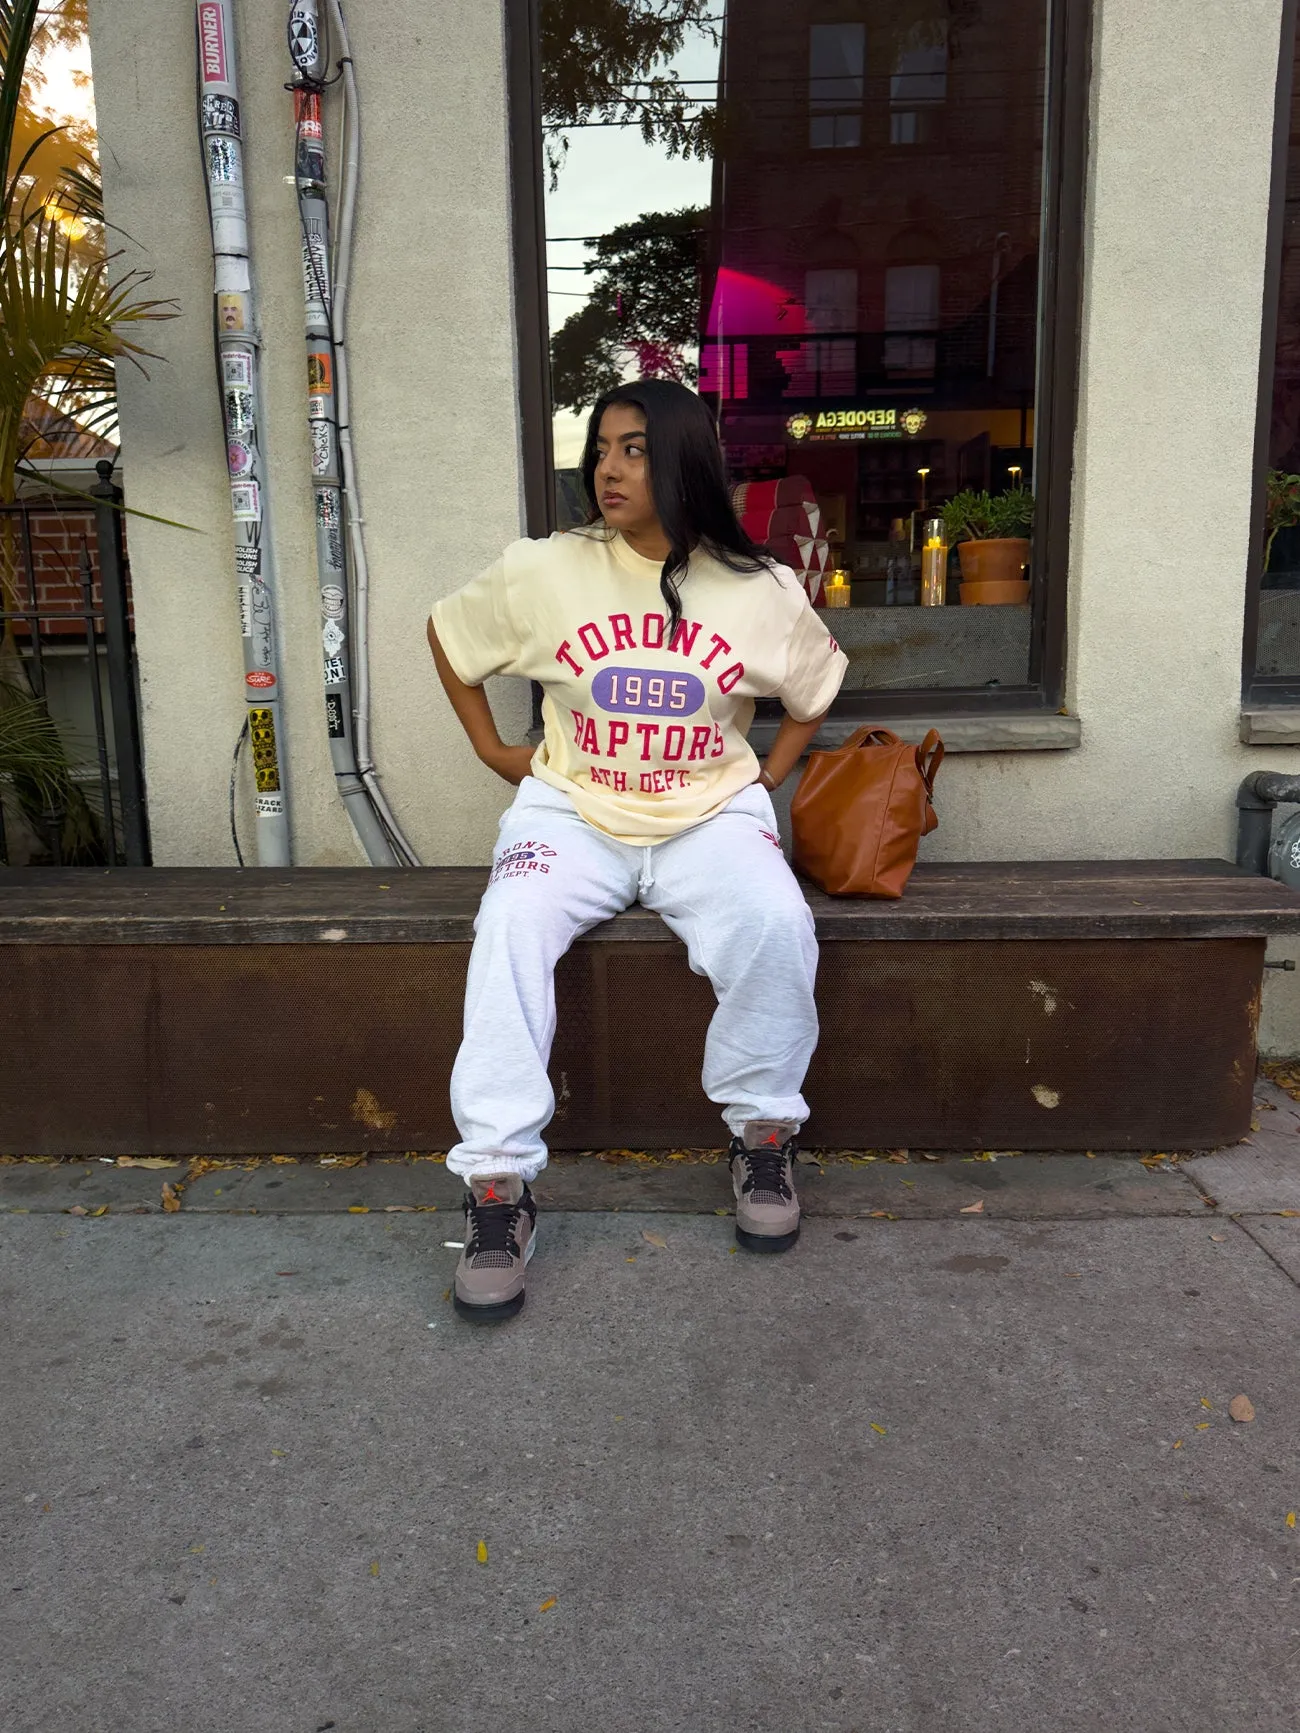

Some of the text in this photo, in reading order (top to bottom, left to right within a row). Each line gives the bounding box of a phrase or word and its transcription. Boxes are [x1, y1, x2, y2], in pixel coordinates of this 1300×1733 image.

[555, 612, 745, 695] TORONTO
[609, 675, 688, 709] 1995
[571, 709, 724, 761] RAPTORS
[590, 766, 691, 794] ATH. DEPT.
